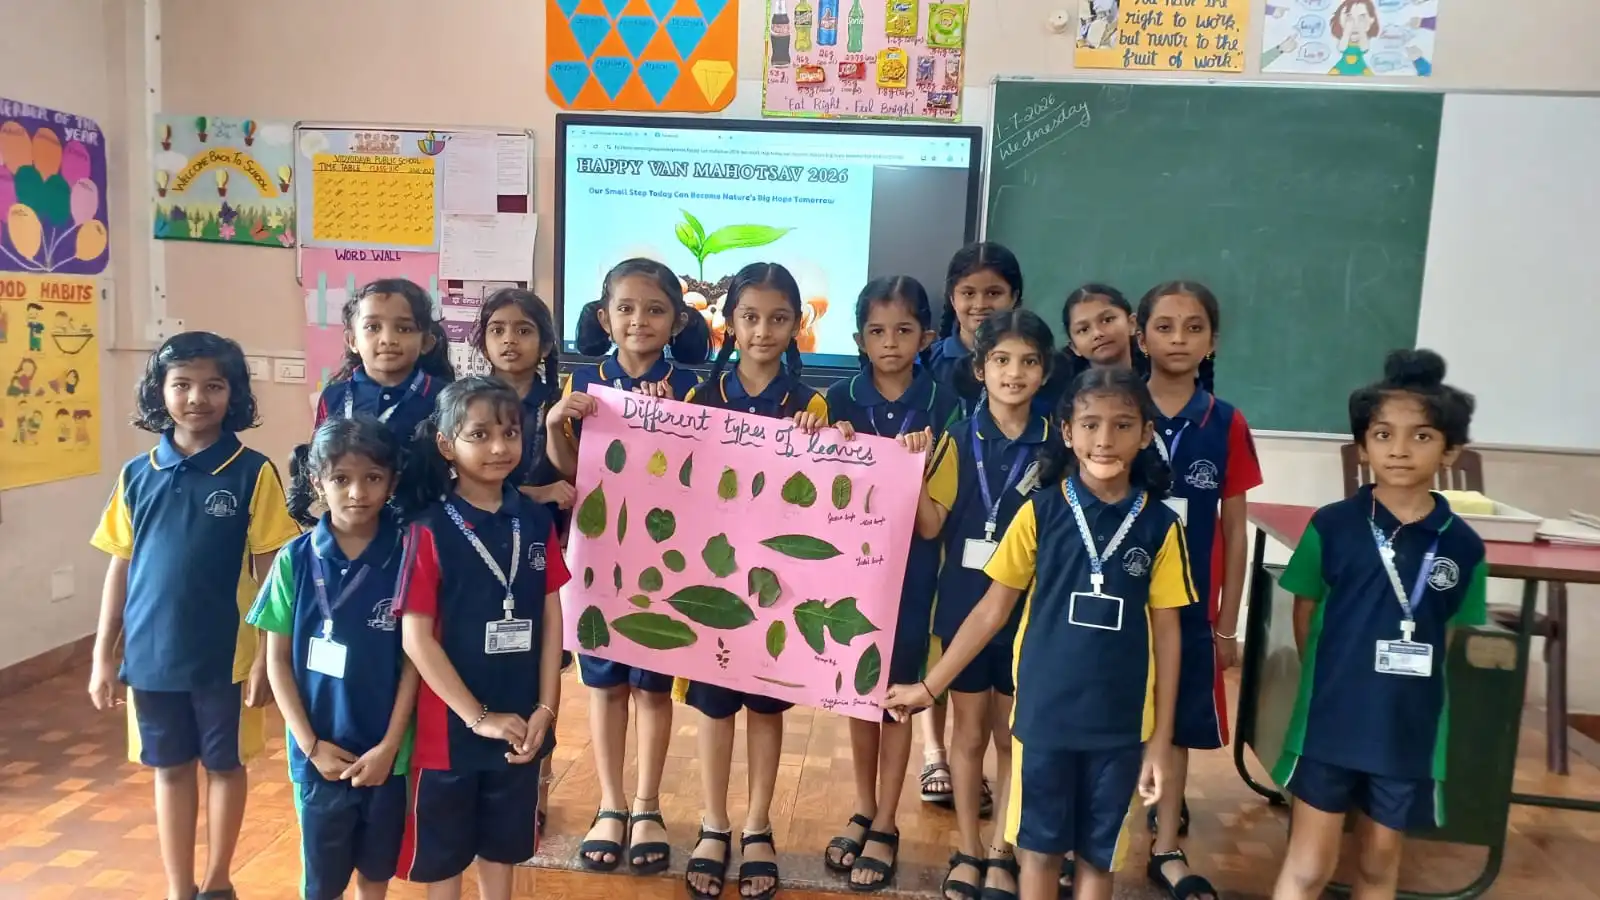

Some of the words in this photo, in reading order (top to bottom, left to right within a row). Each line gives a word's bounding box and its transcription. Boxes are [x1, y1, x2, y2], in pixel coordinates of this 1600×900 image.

[1124, 9, 1163, 30] right
[1173, 11, 1186, 28] to
[1119, 29, 1139, 45] but
[1147, 31, 1188, 47] never
[1196, 33, 1209, 49] to
[1215, 33, 1239, 51] the
[1122, 47, 1159, 68] fruit
[1168, 51, 1183, 68] of
[813, 97, 840, 113] Right
[854, 99, 874, 113] Feel
[54, 112, 71, 124] OF
[64, 127, 99, 147] YEAR
[999, 101, 1091, 161] Wednesday
[319, 162, 336, 172] TIME
[341, 163, 361, 172] TABLE
[577, 157, 643, 175] HAPPY
[648, 160, 689, 177] VAN
[693, 162, 804, 182] MAHOTSAV
[807, 167, 849, 183] 2026
[588, 187, 603, 195] Our
[605, 187, 628, 196] Small
[629, 188, 647, 198] Step
[648, 189, 673, 199] Today
[690, 191, 721, 200] Become
[722, 192, 756, 202] Nature's
[757, 194, 770, 203] Big
[772, 195, 792, 204] Hope
[794, 196, 835, 205] Tomorrow
[335, 249, 367, 261] WORD
[372, 250, 402, 261] WALL
[40, 282, 94, 300] HABITS
[623, 397, 712, 431] Different
[724, 412, 766, 442] types
[775, 424, 799, 457] of
[806, 432, 873, 461] leaves
